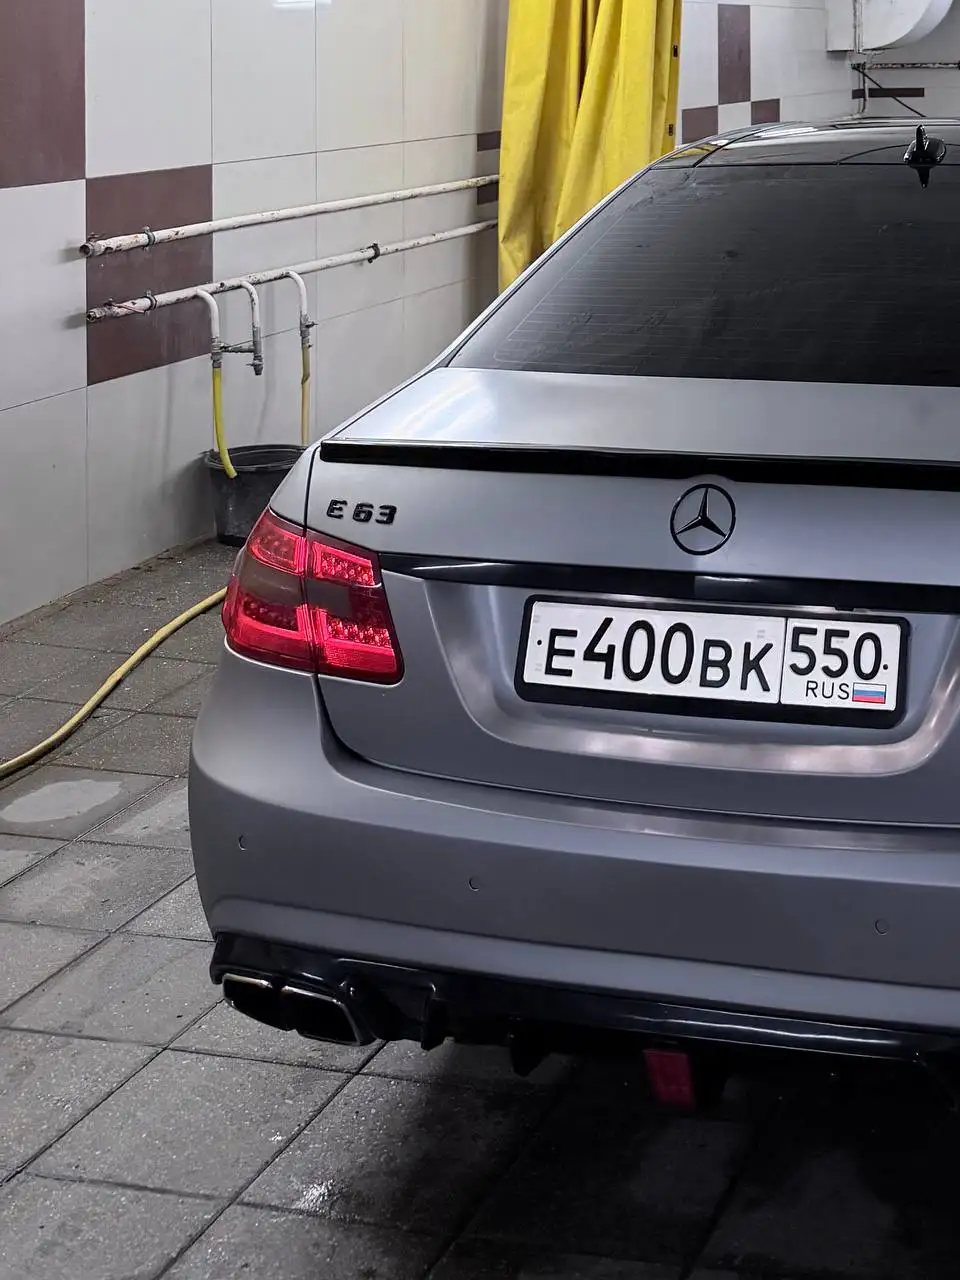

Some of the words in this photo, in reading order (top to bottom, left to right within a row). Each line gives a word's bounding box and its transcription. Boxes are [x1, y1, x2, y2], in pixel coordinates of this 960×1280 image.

[543, 617, 774, 693] E400BK
[788, 626, 883, 681] 550
[804, 679, 851, 701] RUS
